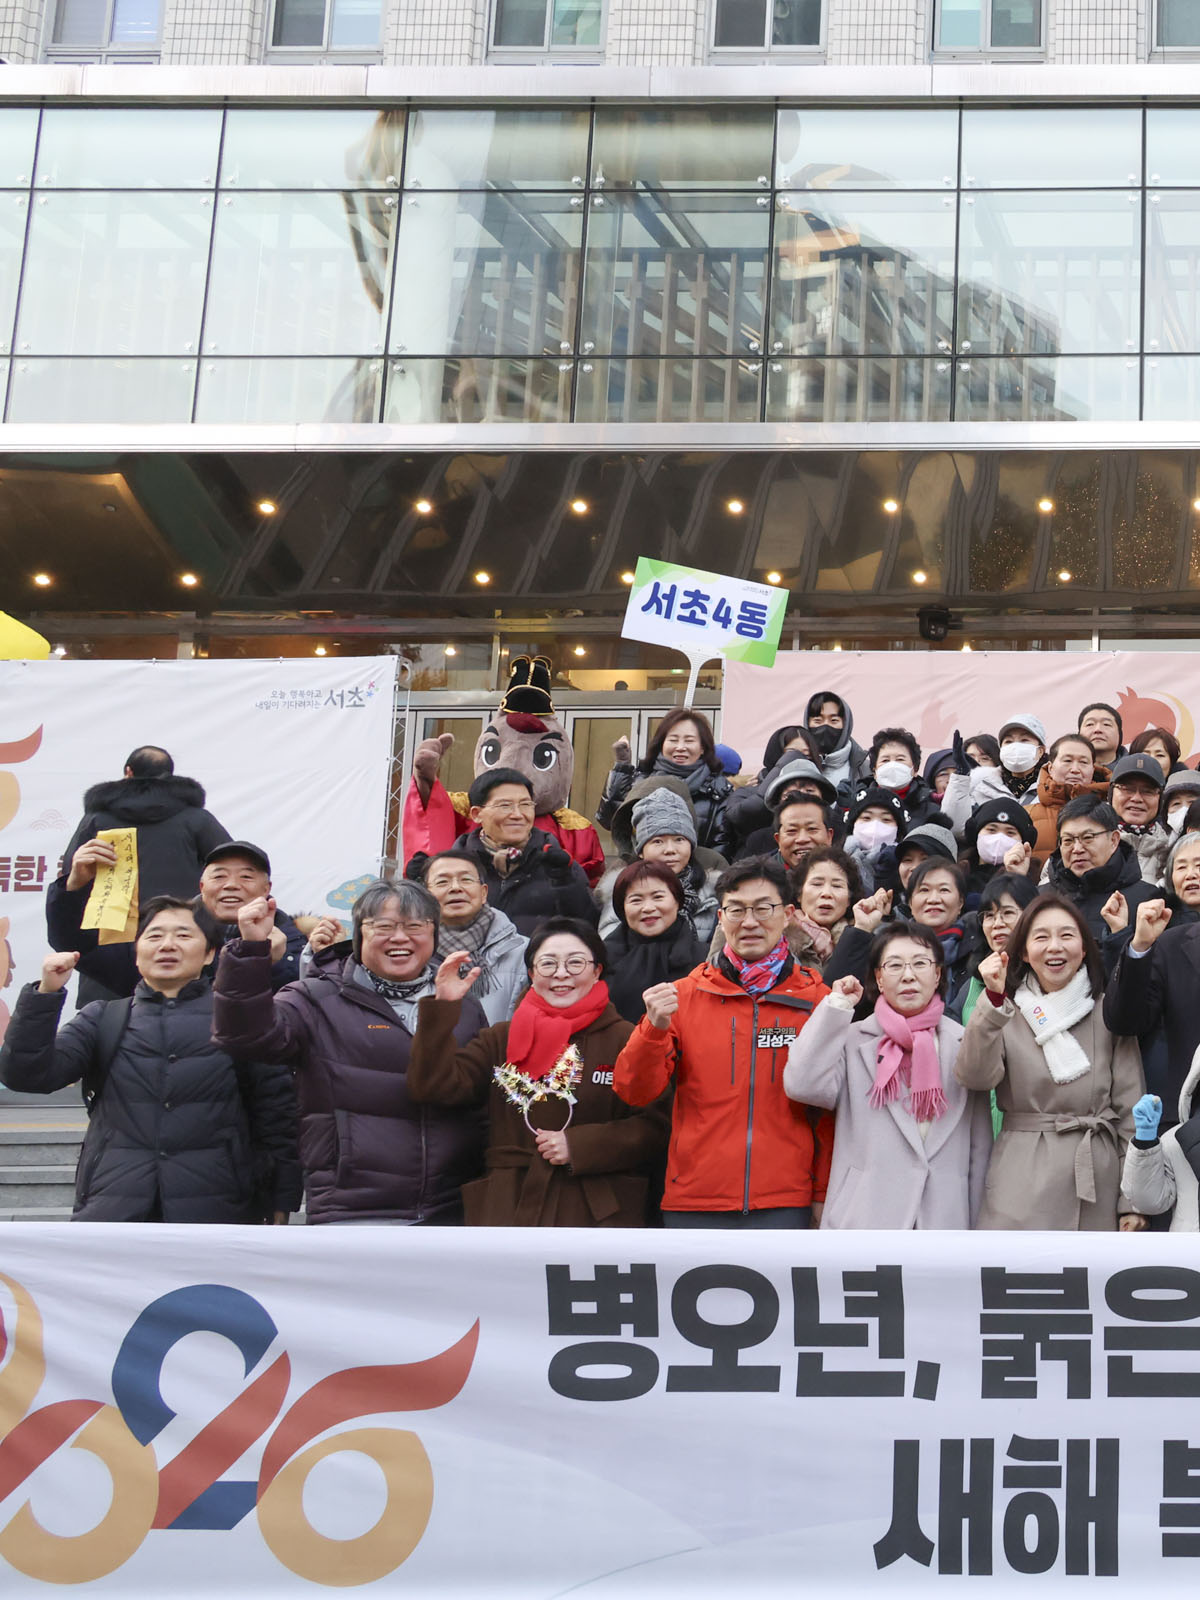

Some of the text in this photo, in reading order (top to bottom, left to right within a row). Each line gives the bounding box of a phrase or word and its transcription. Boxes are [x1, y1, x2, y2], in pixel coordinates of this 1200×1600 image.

[641, 581, 768, 638] 서초4동
[323, 686, 365, 709] 서초
[757, 1034, 797, 1048] 김성주
[545, 1263, 941, 1402] 병오년,
[873, 1434, 1120, 1577] 새해
